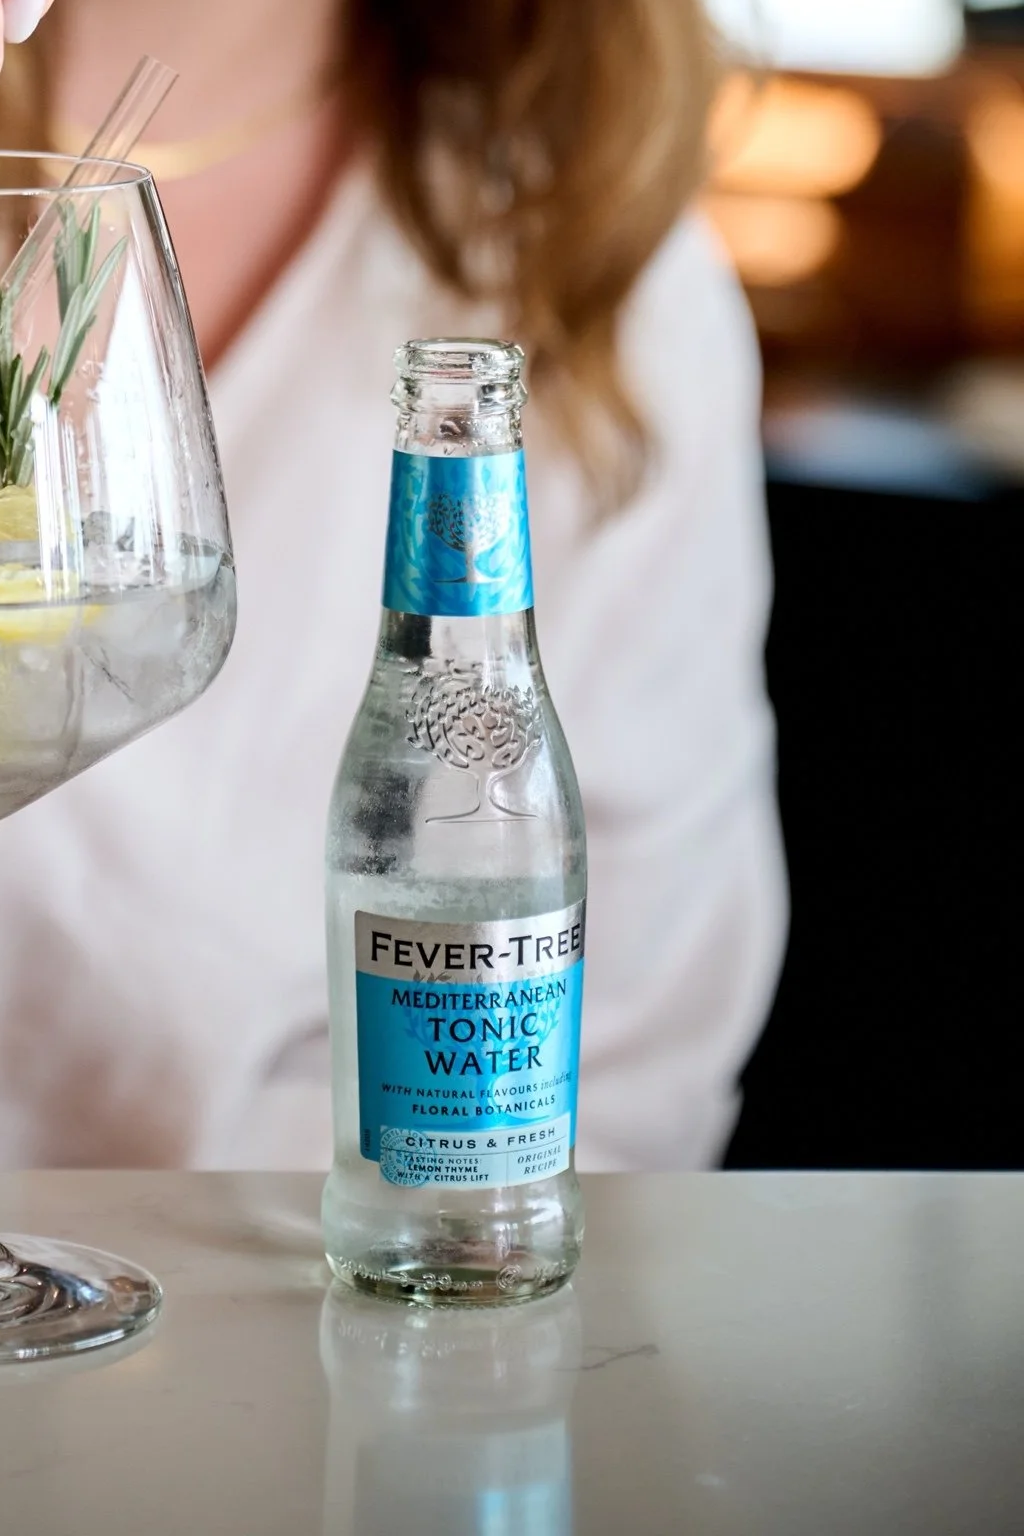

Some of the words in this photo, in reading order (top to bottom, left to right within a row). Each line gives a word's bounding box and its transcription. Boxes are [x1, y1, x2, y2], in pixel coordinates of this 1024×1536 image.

[371, 922, 581, 970] FEVER-TREE
[391, 978, 567, 1010] MEDITERRANEAN
[427, 1012, 538, 1043] TONIC
[424, 1045, 542, 1076] WATER
[381, 1083, 412, 1096] WITH
[416, 1088, 475, 1099] NATURAL
[479, 1083, 538, 1099] FLAVOURS
[412, 1104, 469, 1117] FLORAL
[475, 1094, 556, 1116] BOTANICALS
[405, 1136, 476, 1149] CITRUS
[486, 1138, 497, 1148] &
[507, 1127, 556, 1146] FRESH
[404, 1154, 444, 1165] TASTING
[517, 1145, 562, 1165] ORIGINAL
[396, 1170, 421, 1181] WITH
[434, 1173, 468, 1182] CITRUS
[470, 1173, 489, 1182] LIFT
[408, 1164, 442, 1173] LEMON
[523, 1158, 558, 1176] RECIPE
